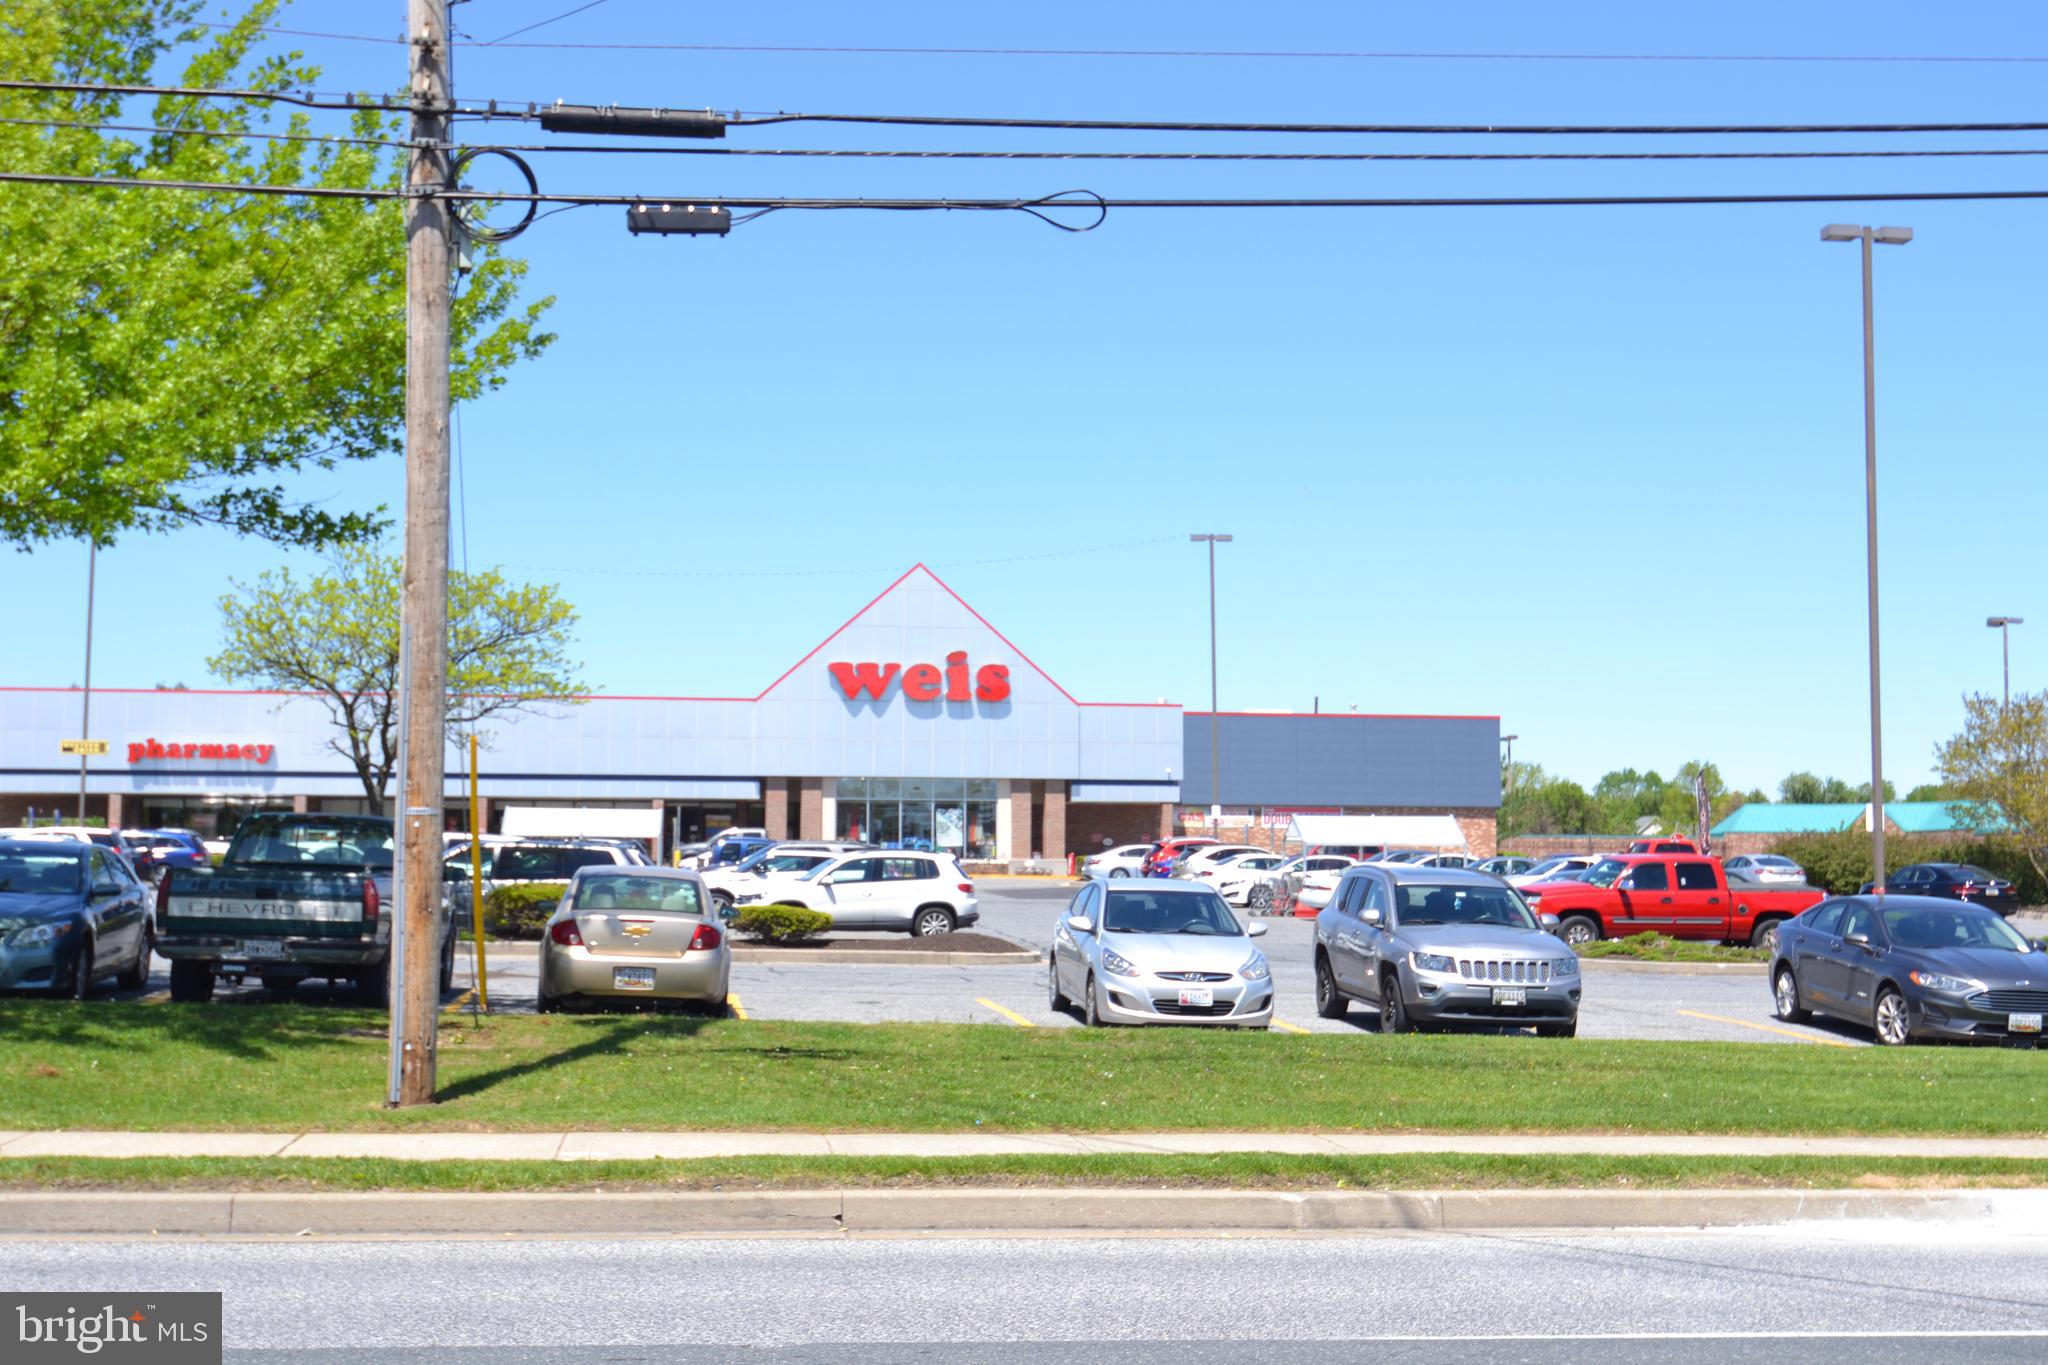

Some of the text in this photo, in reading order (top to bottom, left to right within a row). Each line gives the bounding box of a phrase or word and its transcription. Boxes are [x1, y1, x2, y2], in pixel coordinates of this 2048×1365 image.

[828, 650, 1011, 702] weis
[127, 738, 274, 764] pharmacy
[188, 901, 343, 918] CHEVROLET
